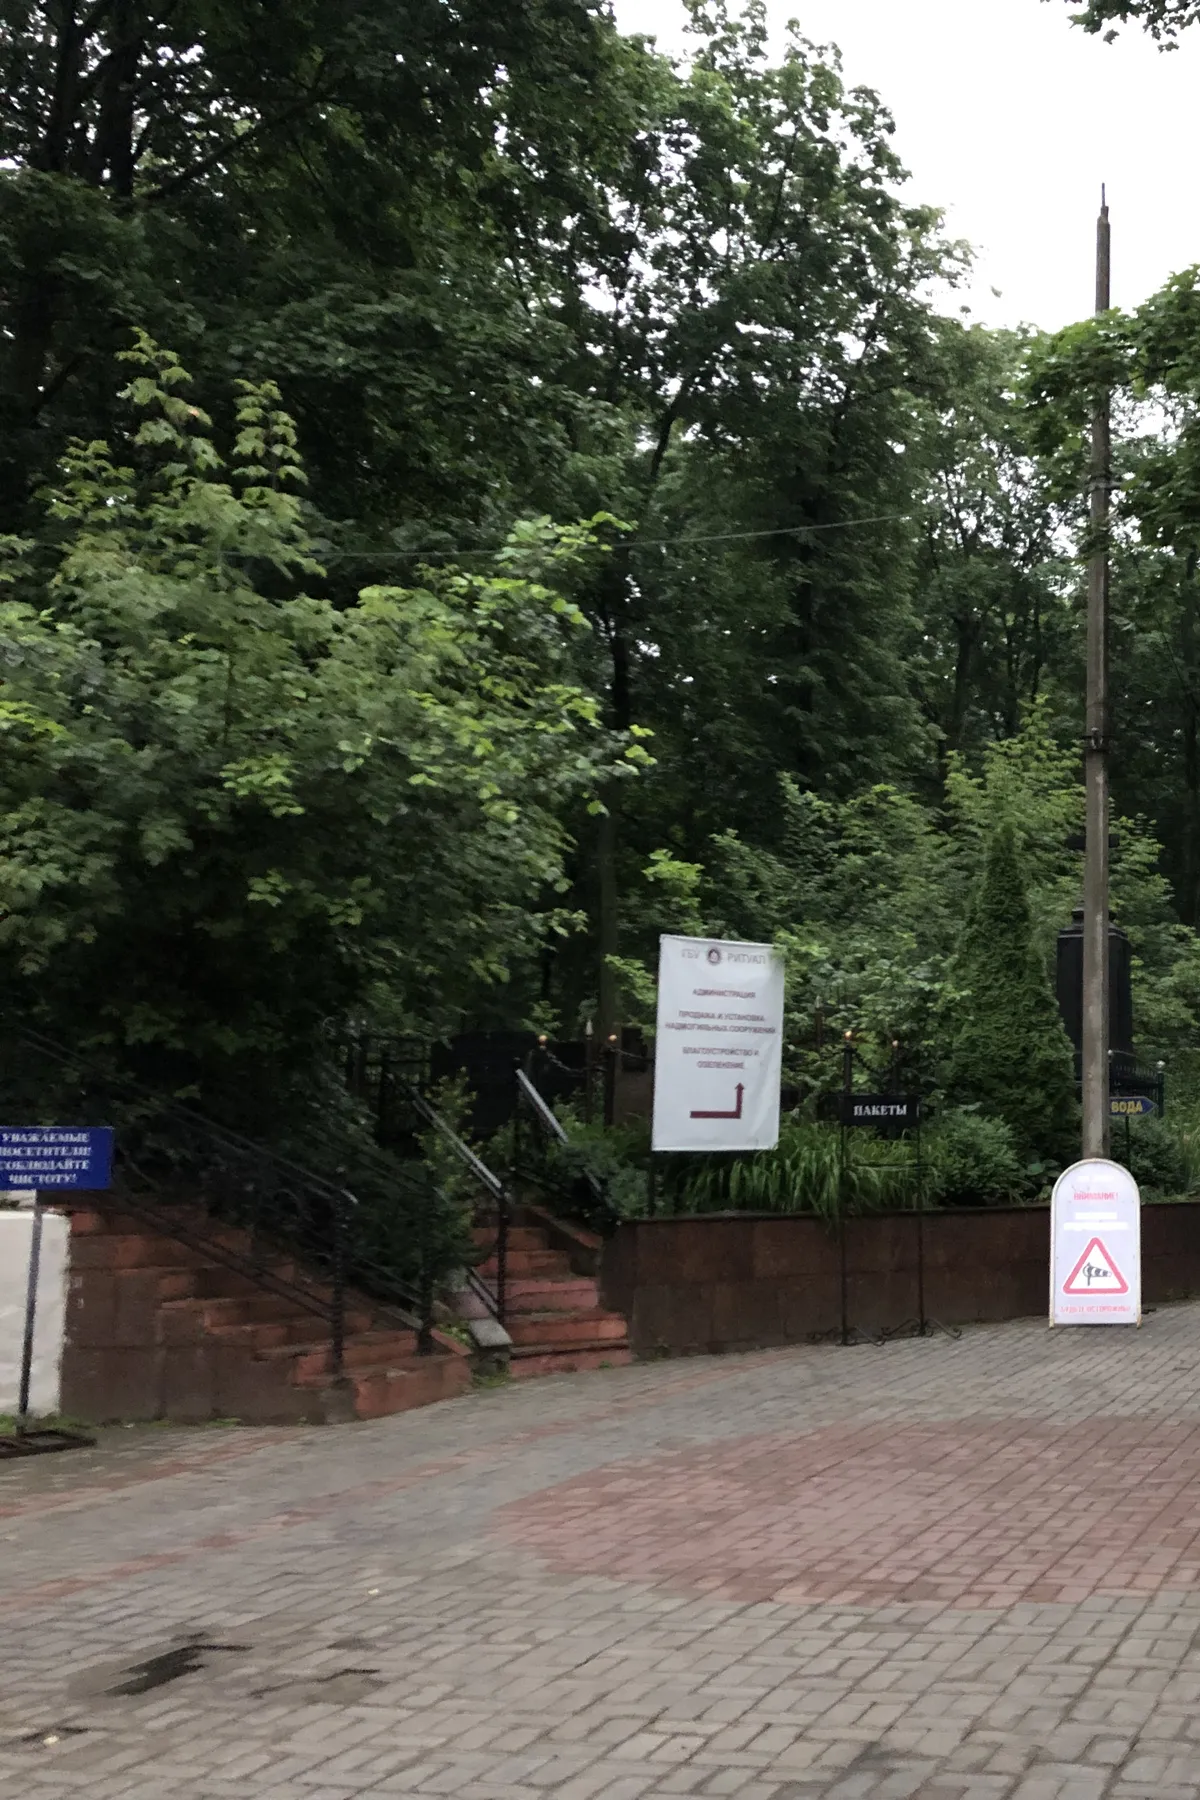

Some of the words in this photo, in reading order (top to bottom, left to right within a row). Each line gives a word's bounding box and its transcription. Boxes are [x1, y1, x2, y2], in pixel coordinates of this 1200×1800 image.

[727, 952, 766, 964] РИТУАЛ
[692, 988, 756, 998] АДМИНИСТРАЦИЯ
[679, 1010, 715, 1019] ПРОДАЖА
[724, 1012, 765, 1021] УСТАНОВКА
[853, 1105, 907, 1116] ПАКЕТЫ
[1111, 1101, 1143, 1114] ВОДА
[2, 1133, 90, 1143] УВАЖАЕМЫЕ
[9, 1174, 77, 1183] ЧИСТОТУ!
[1073, 1192, 1119, 1200] ВНИМАНИЕ!
